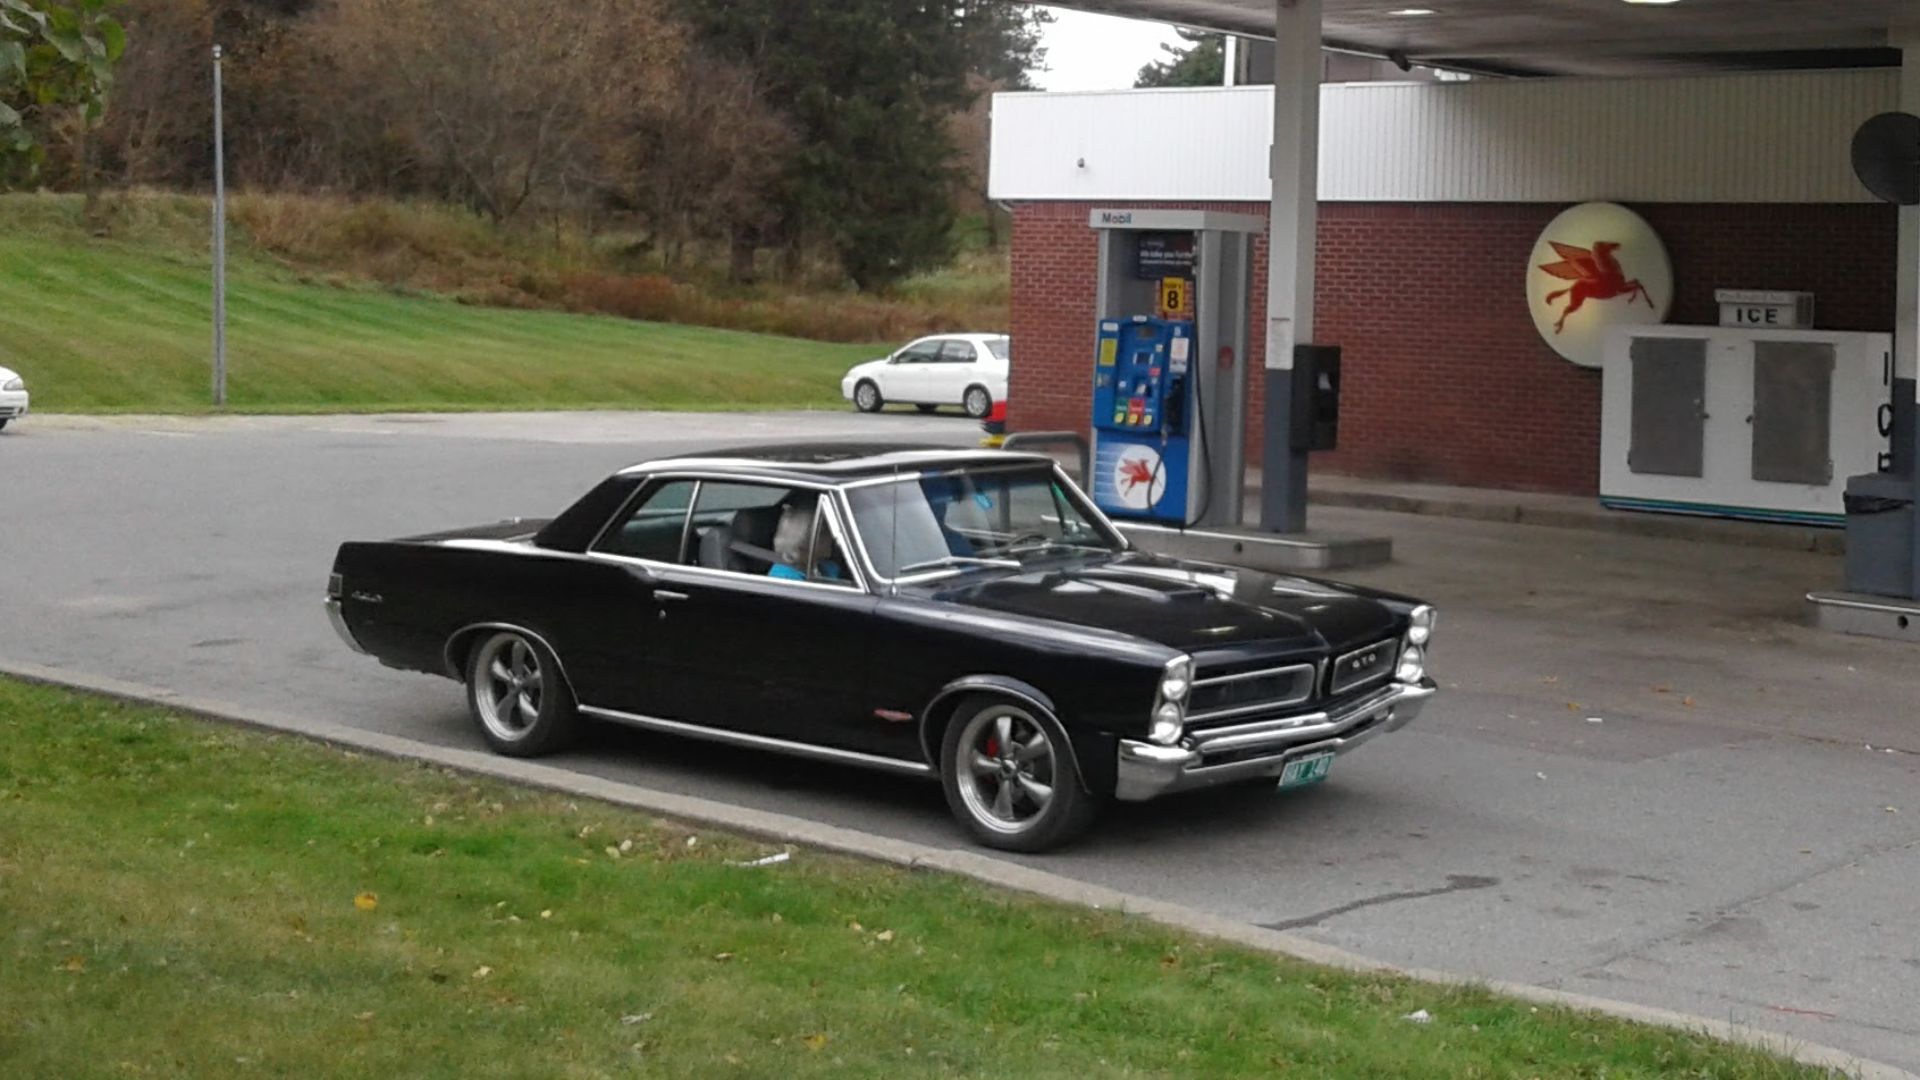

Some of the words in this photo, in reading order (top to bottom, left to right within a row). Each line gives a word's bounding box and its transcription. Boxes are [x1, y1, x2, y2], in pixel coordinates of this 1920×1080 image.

[1102, 212, 1132, 224] Mobil
[1167, 290, 1179, 309] 8
[1736, 308, 1778, 324] ICE
[1352, 653, 1376, 668] GTO
